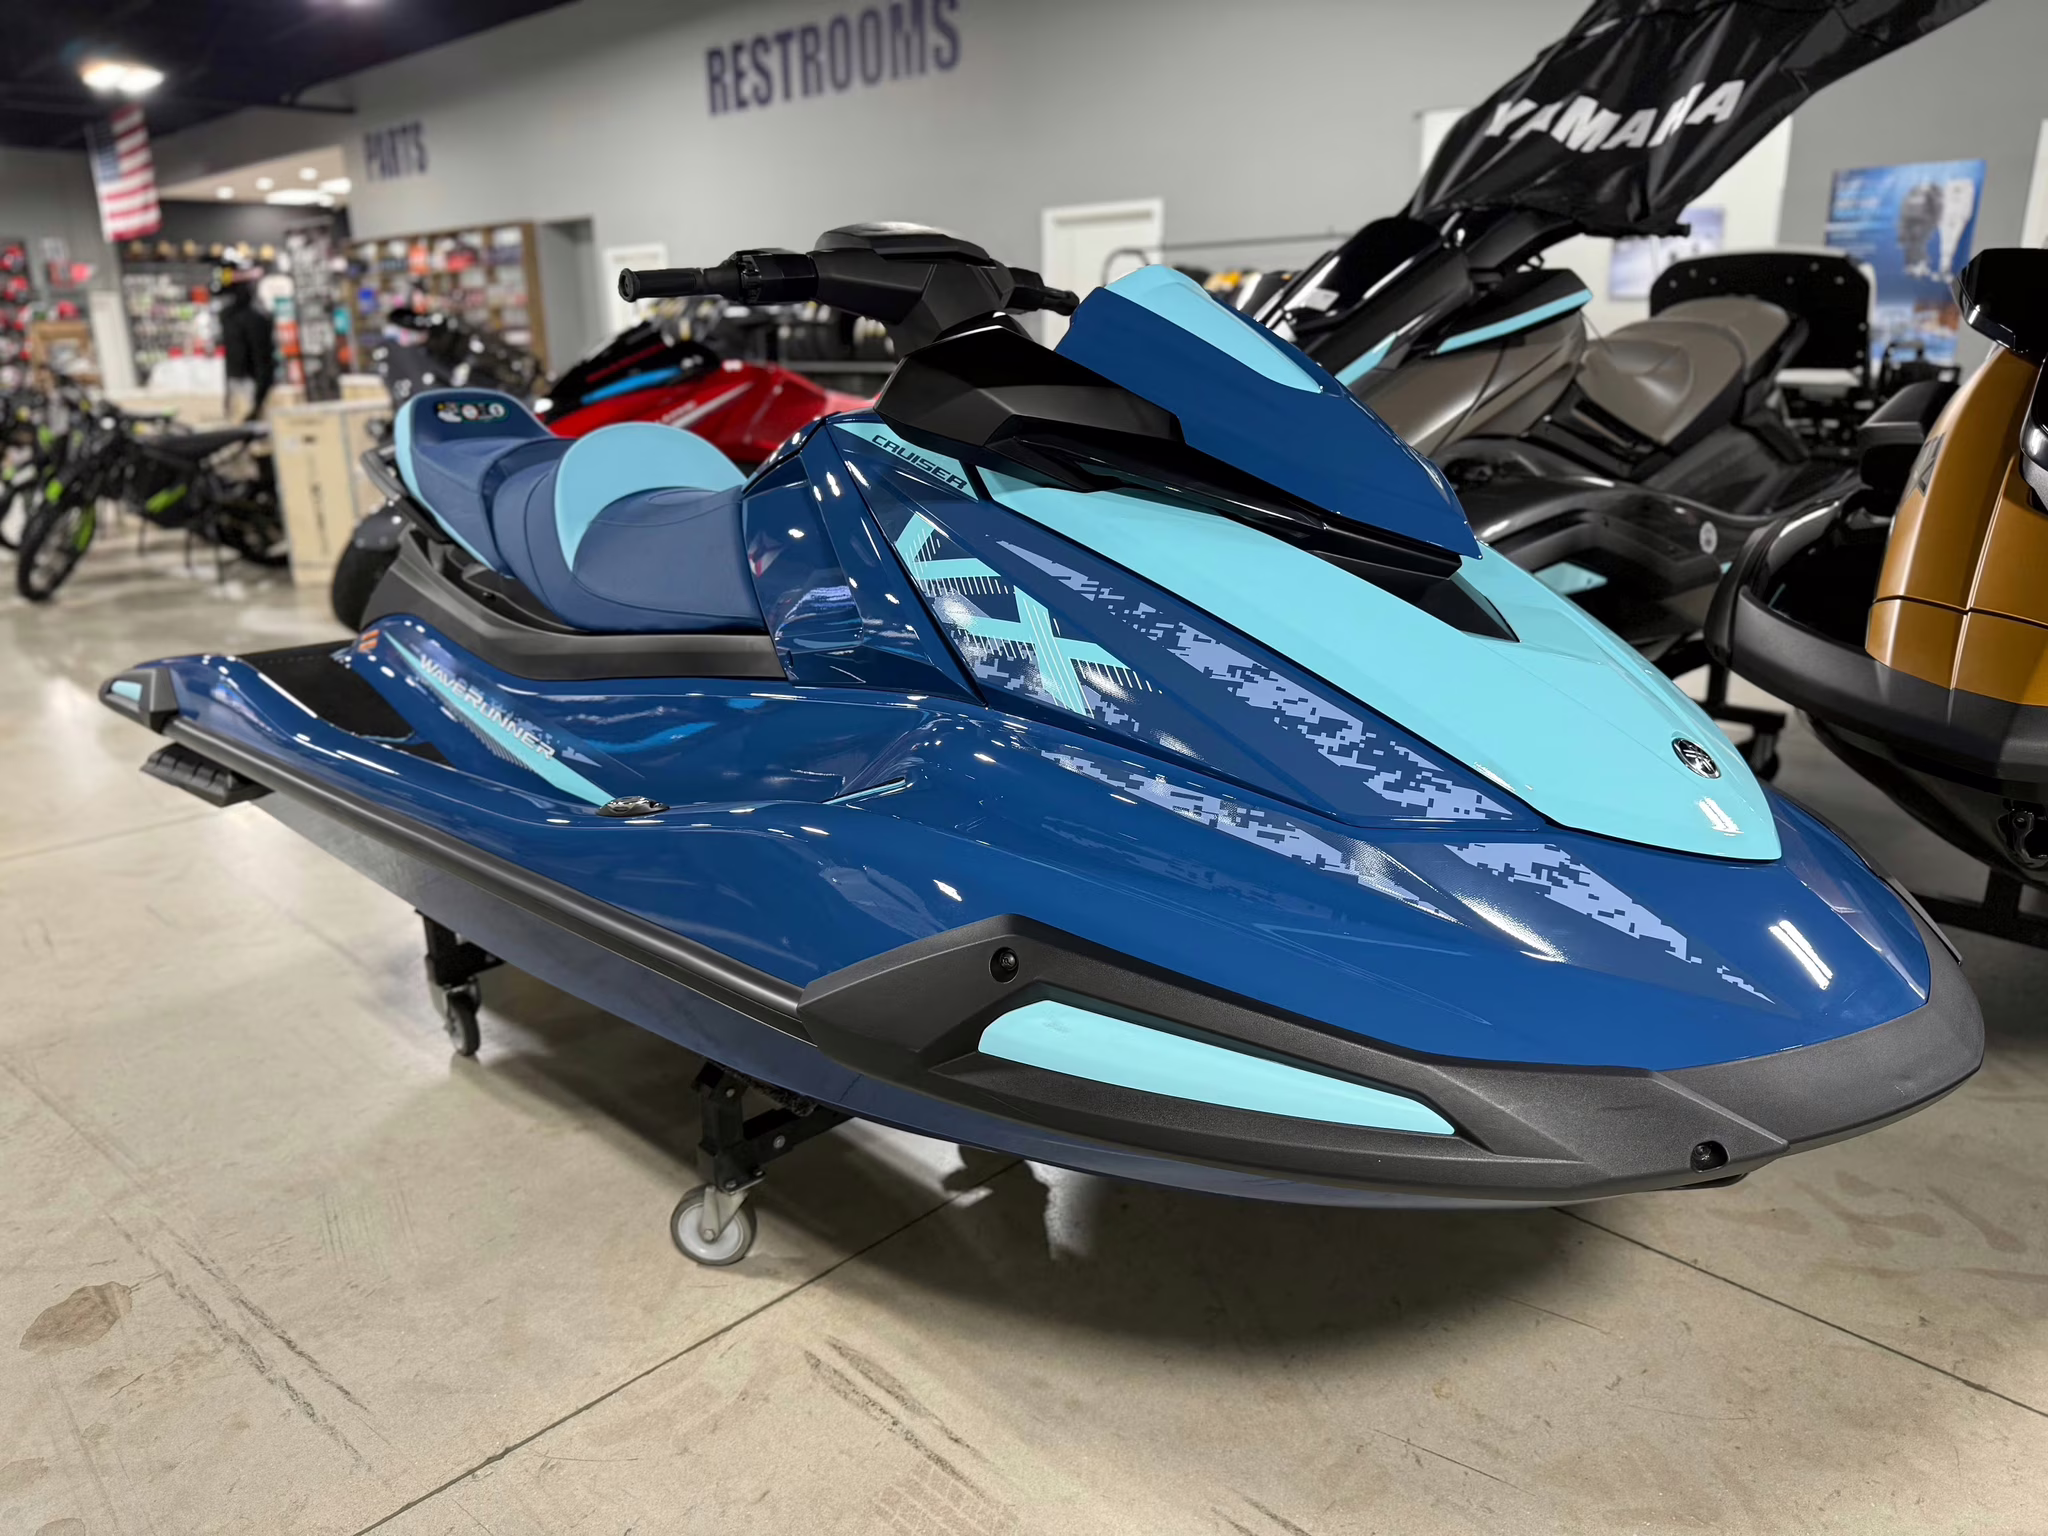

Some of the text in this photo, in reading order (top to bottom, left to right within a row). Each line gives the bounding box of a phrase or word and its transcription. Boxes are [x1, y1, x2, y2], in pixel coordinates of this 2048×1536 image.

[707, 0, 961, 116] RESTROOMS
[1484, 79, 1746, 153] YAMAHA
[363, 120, 430, 182] PARTS
[871, 434, 968, 490] CRUISER
